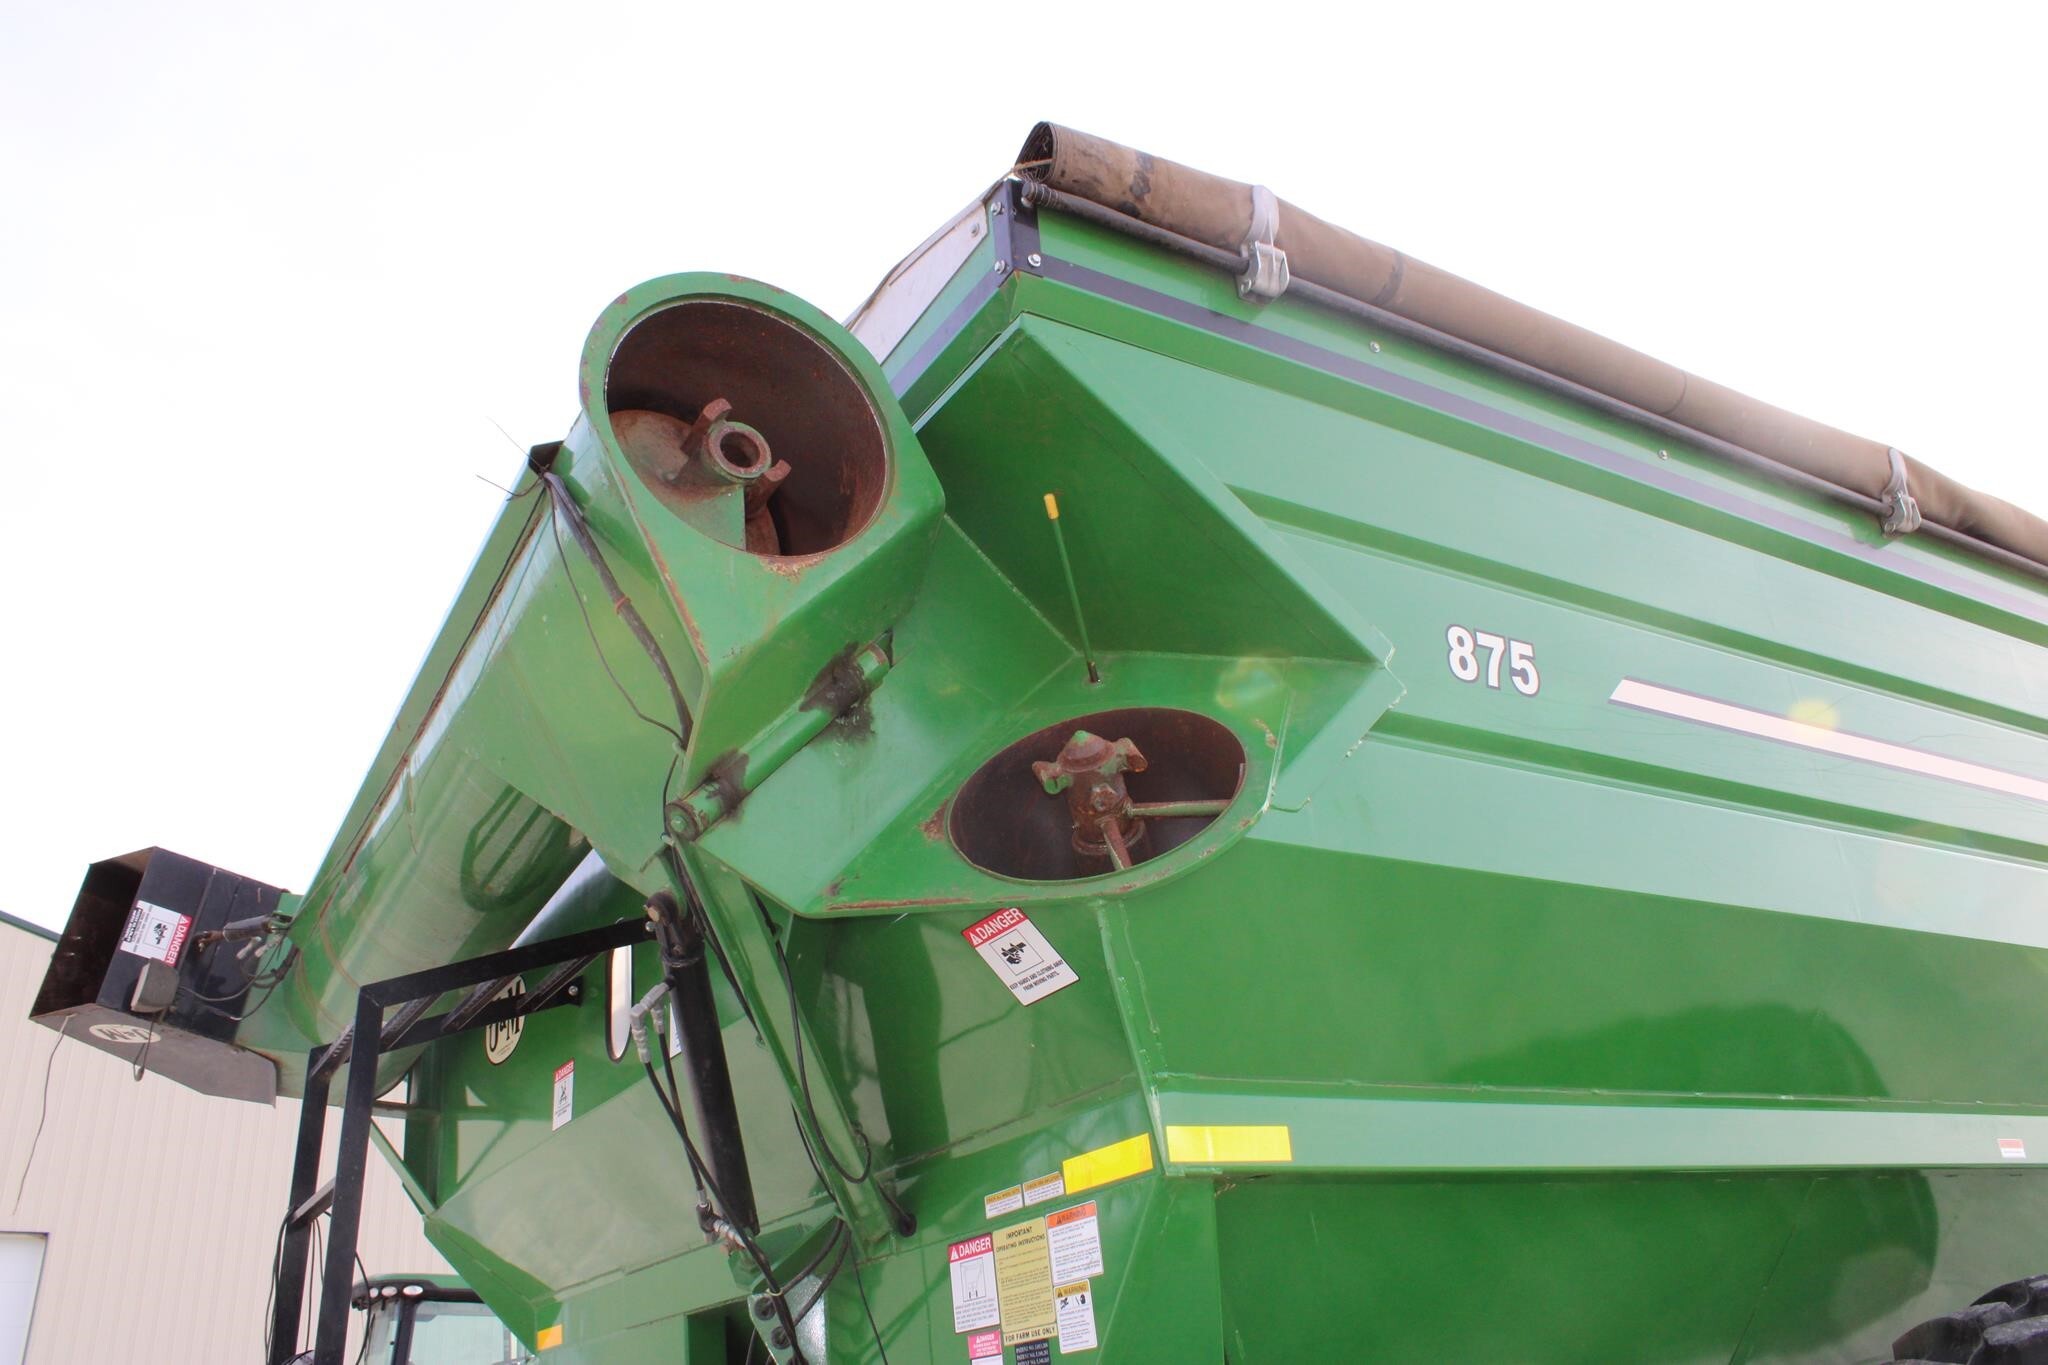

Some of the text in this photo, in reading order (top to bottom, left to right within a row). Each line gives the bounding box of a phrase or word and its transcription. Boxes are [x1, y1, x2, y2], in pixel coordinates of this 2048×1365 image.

[1446, 624, 1540, 696] 875
[976, 908, 1024, 940] DANGER
[165, 925, 189, 965] DANGER
[959, 1238, 992, 1256] DANGER
[1005, 1327, 1055, 1342] FOR FARM USE ONLY
